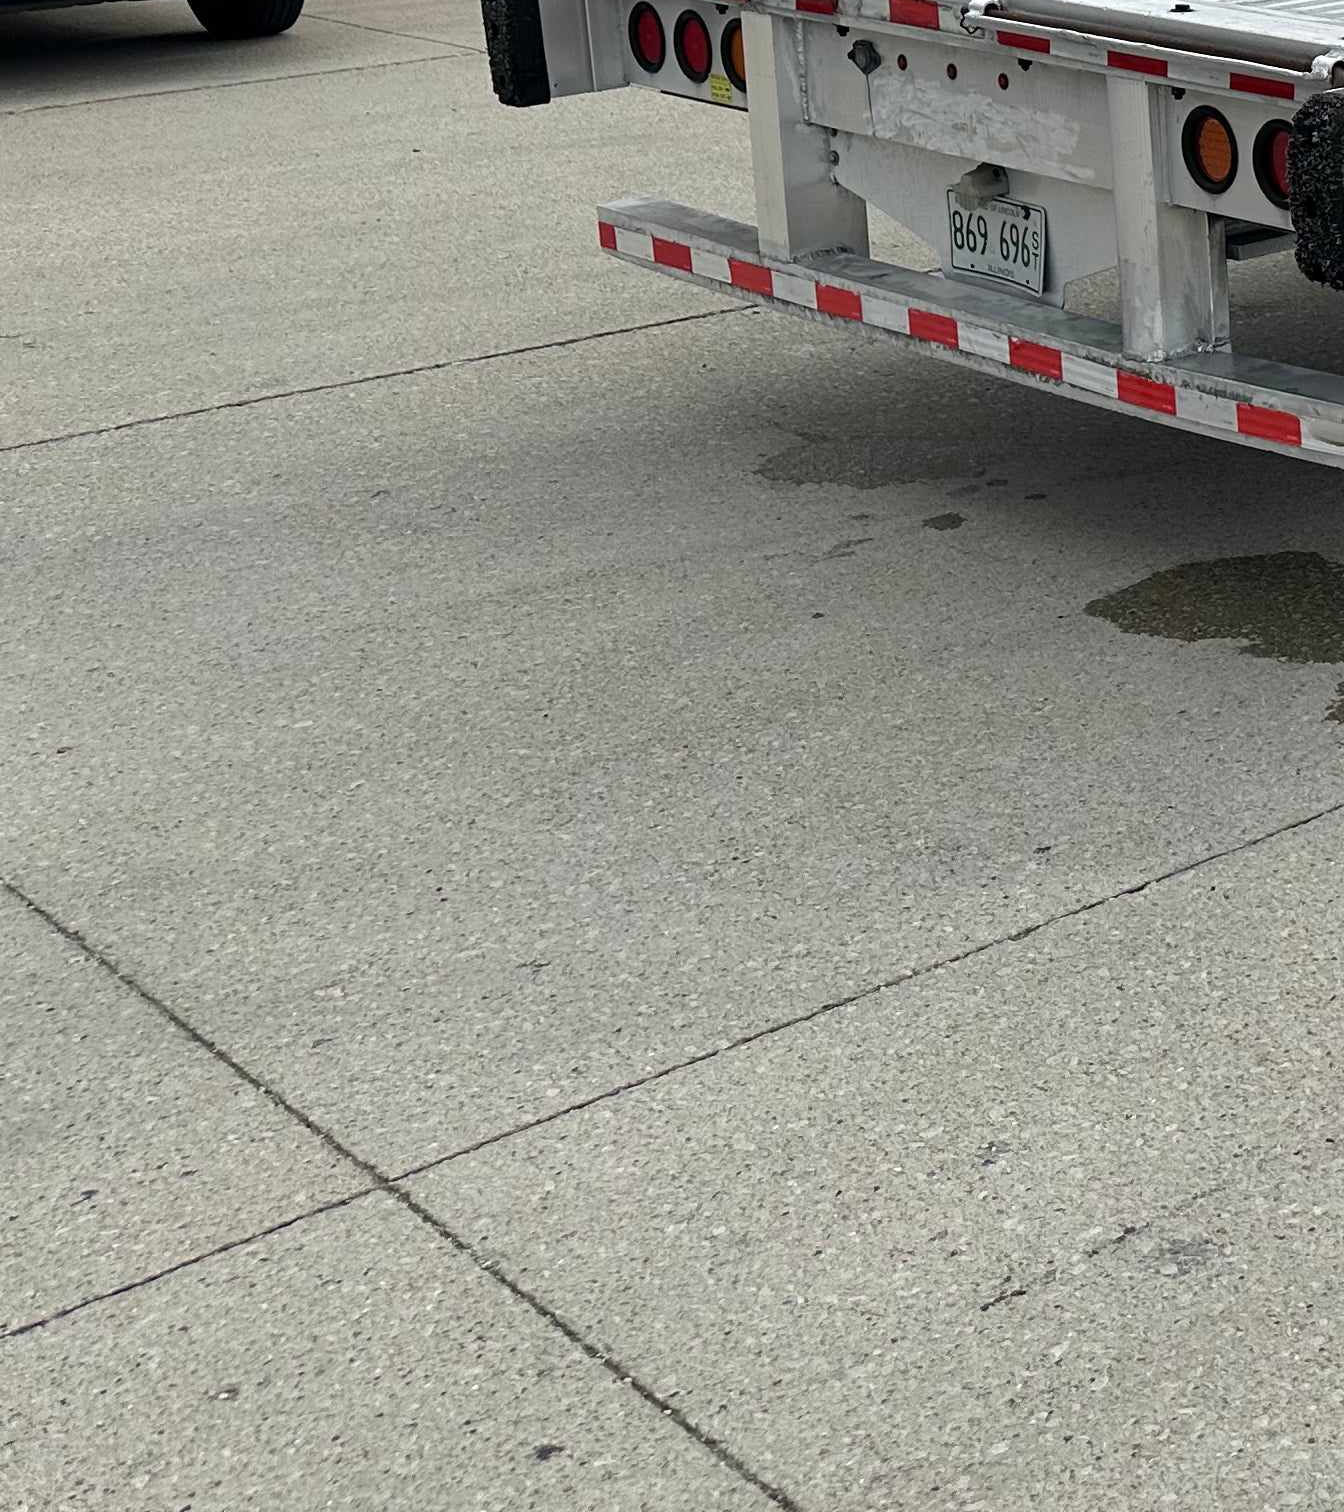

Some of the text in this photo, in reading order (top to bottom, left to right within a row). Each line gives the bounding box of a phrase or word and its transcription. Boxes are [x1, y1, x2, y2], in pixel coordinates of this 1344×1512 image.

[952, 210, 1031, 268] 869 696
[987, 264, 1015, 279] ILLINOIS
